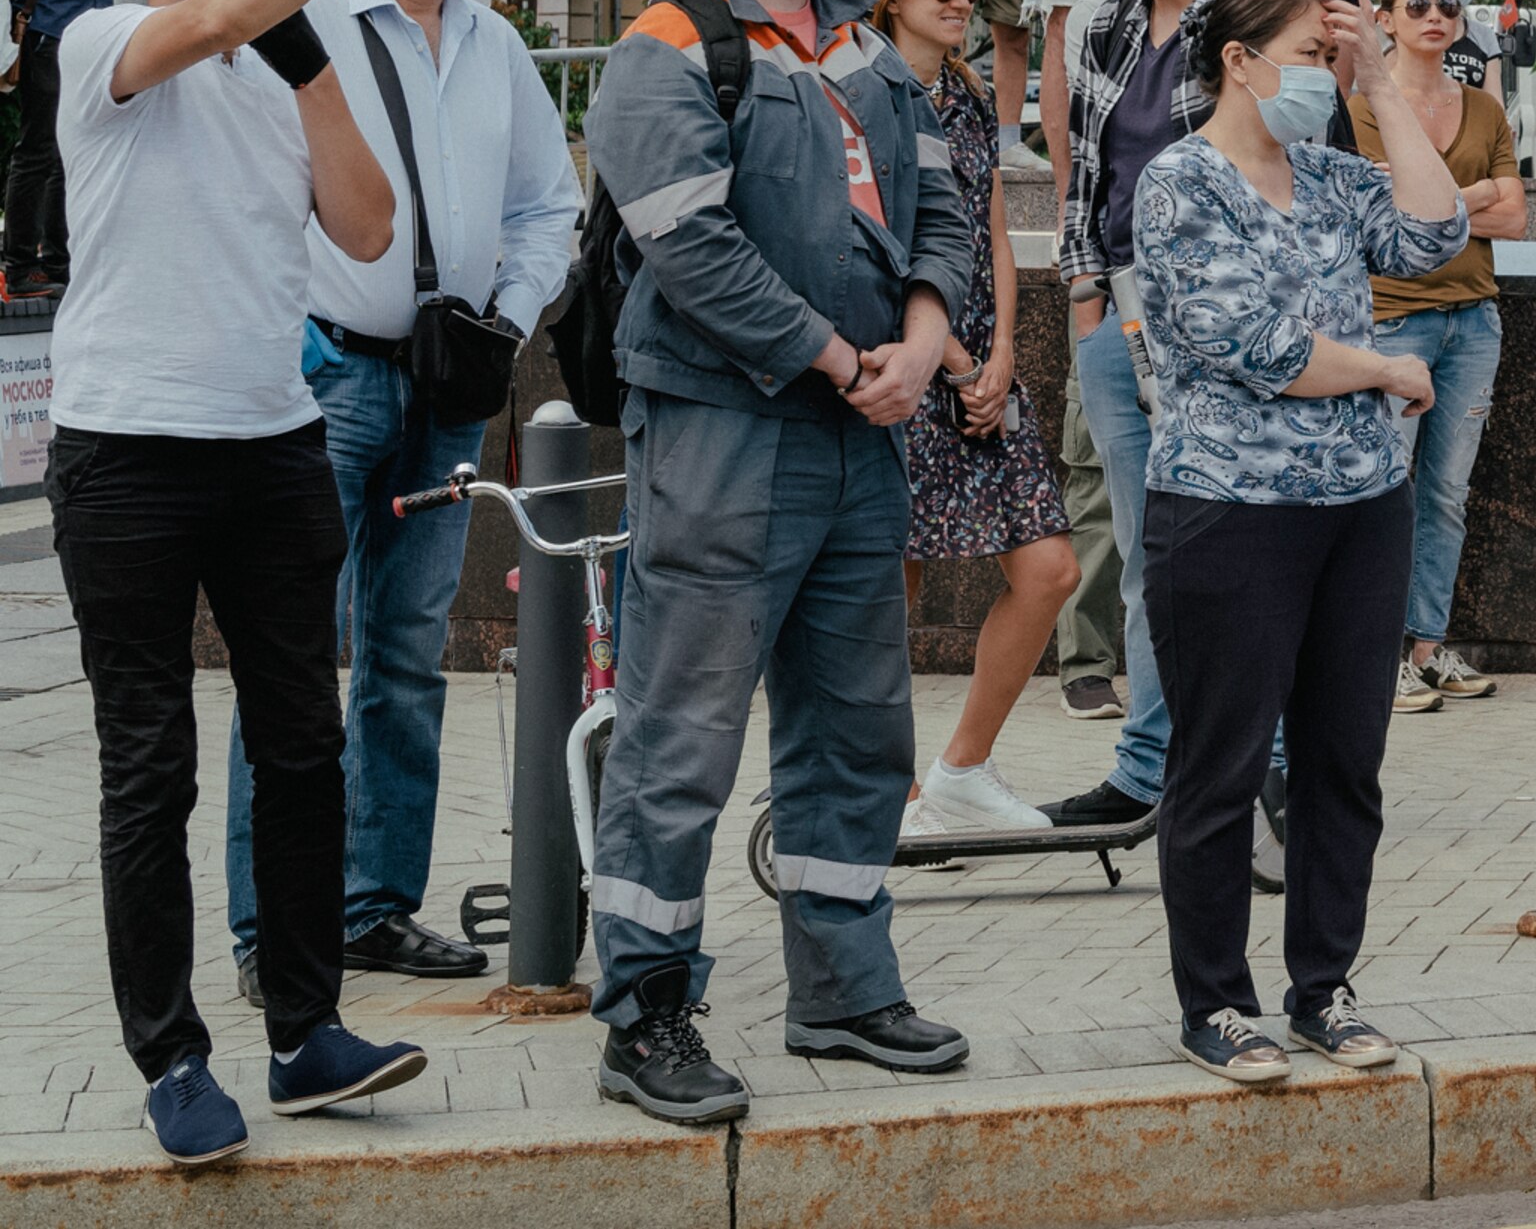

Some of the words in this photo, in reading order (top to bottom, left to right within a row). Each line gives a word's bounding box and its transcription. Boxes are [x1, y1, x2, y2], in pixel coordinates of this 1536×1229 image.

[1448, 51, 1485, 74] YORK
[14, 356, 41, 375] афиша
[10, 408, 27, 425] тебя
